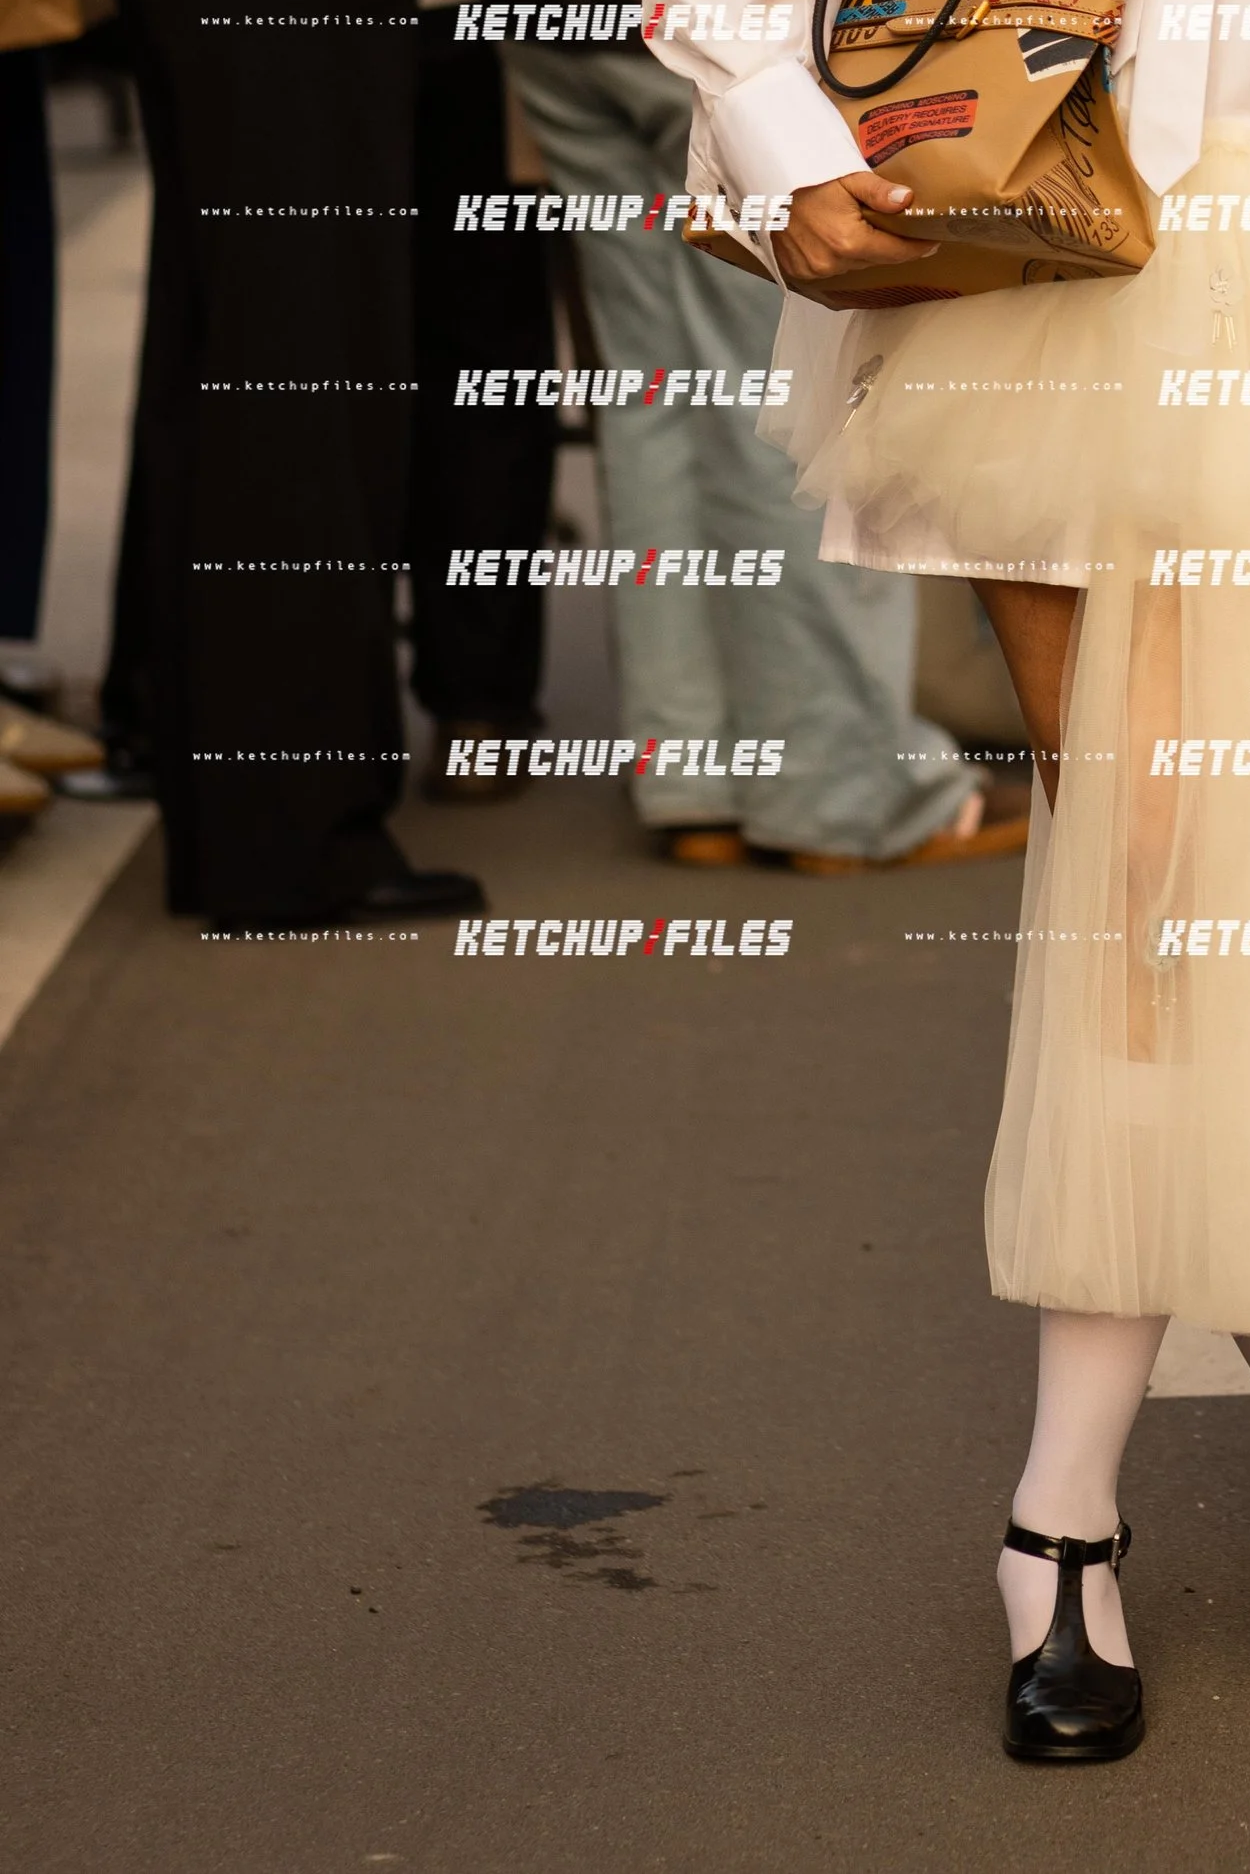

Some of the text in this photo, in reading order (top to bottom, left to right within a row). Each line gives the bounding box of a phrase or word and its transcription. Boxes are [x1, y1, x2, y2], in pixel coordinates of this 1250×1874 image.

[865, 115, 970, 150] RECIPIENT SIGNATURE
[866, 105, 967, 134] DELIVERY REQUIRES
